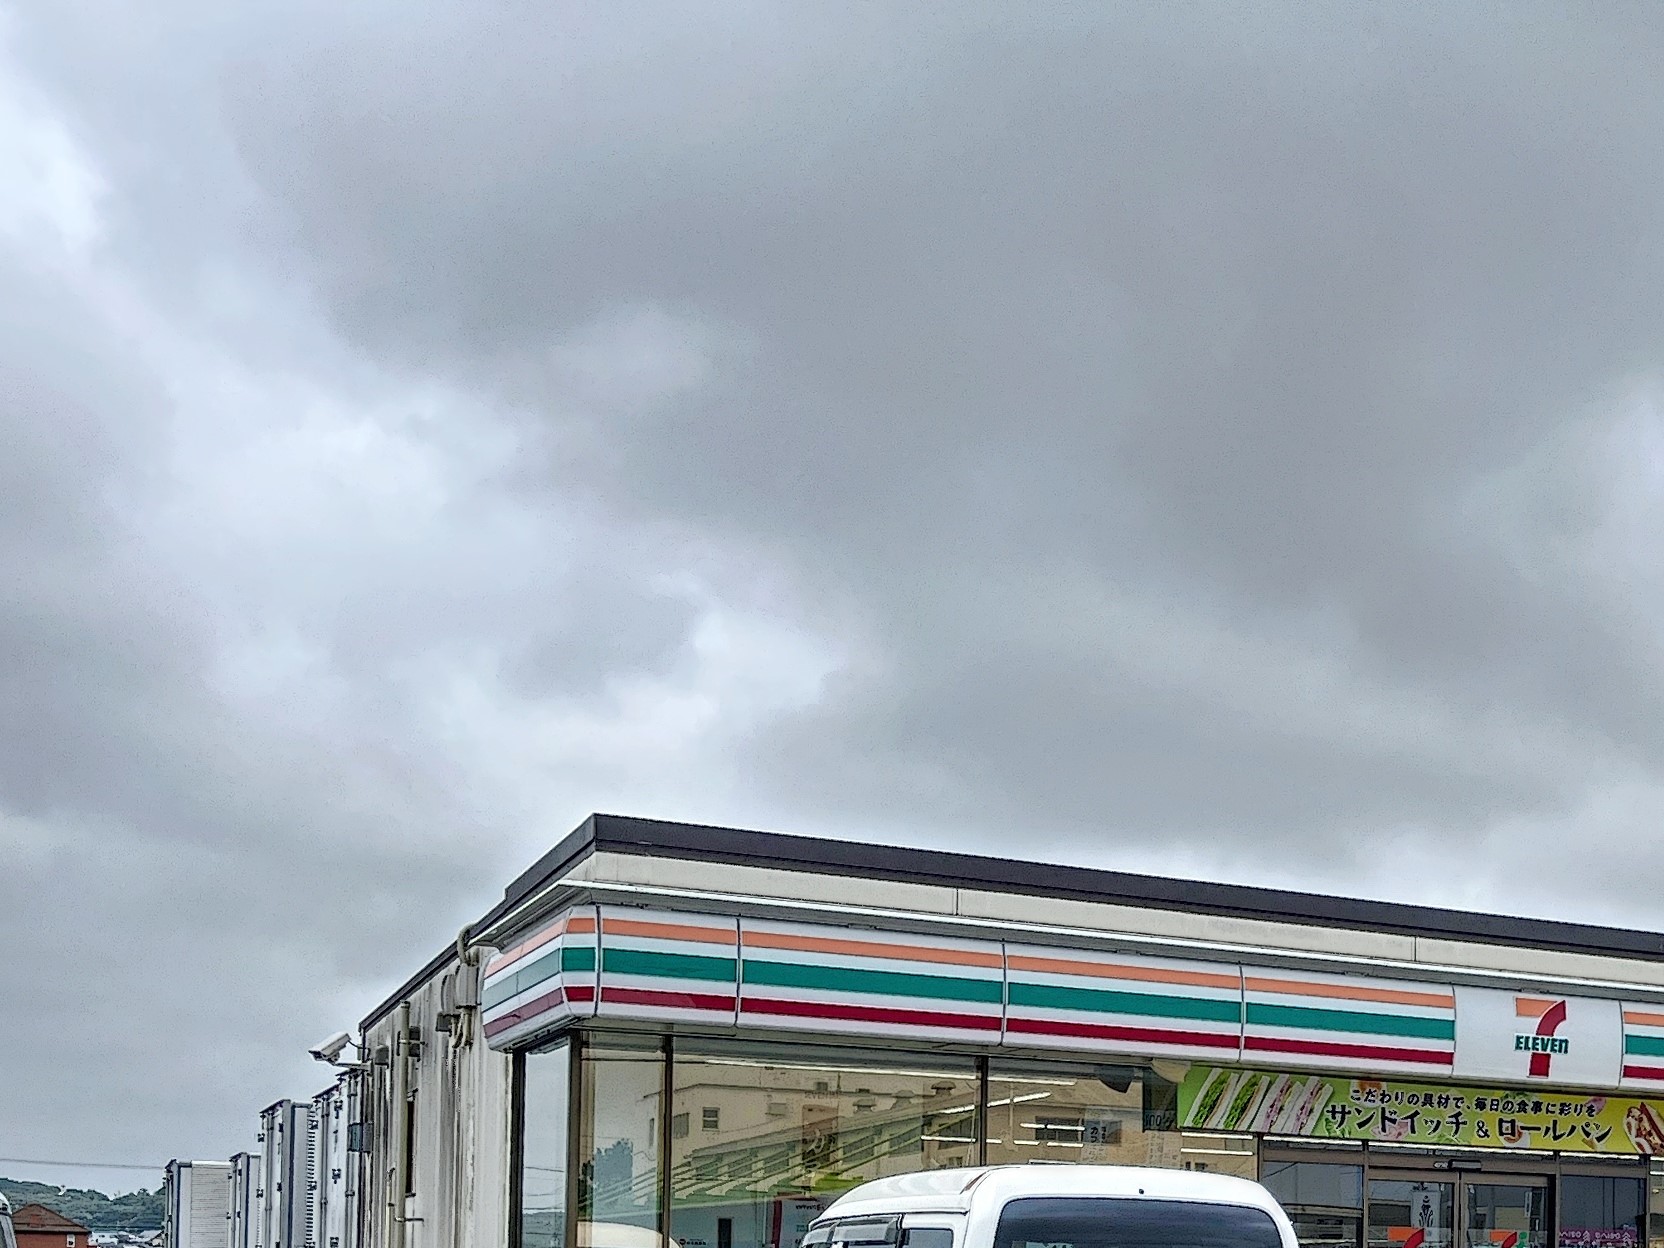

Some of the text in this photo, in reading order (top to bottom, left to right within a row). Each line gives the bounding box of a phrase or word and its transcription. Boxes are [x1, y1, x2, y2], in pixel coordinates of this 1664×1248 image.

[1350, 1088, 1596, 1118] こだわりの具材で、毎日の食事に彩りを
[1325, 1104, 1468, 1138] サンドイッチ
[1498, 1118, 1613, 1143] ロールパン
